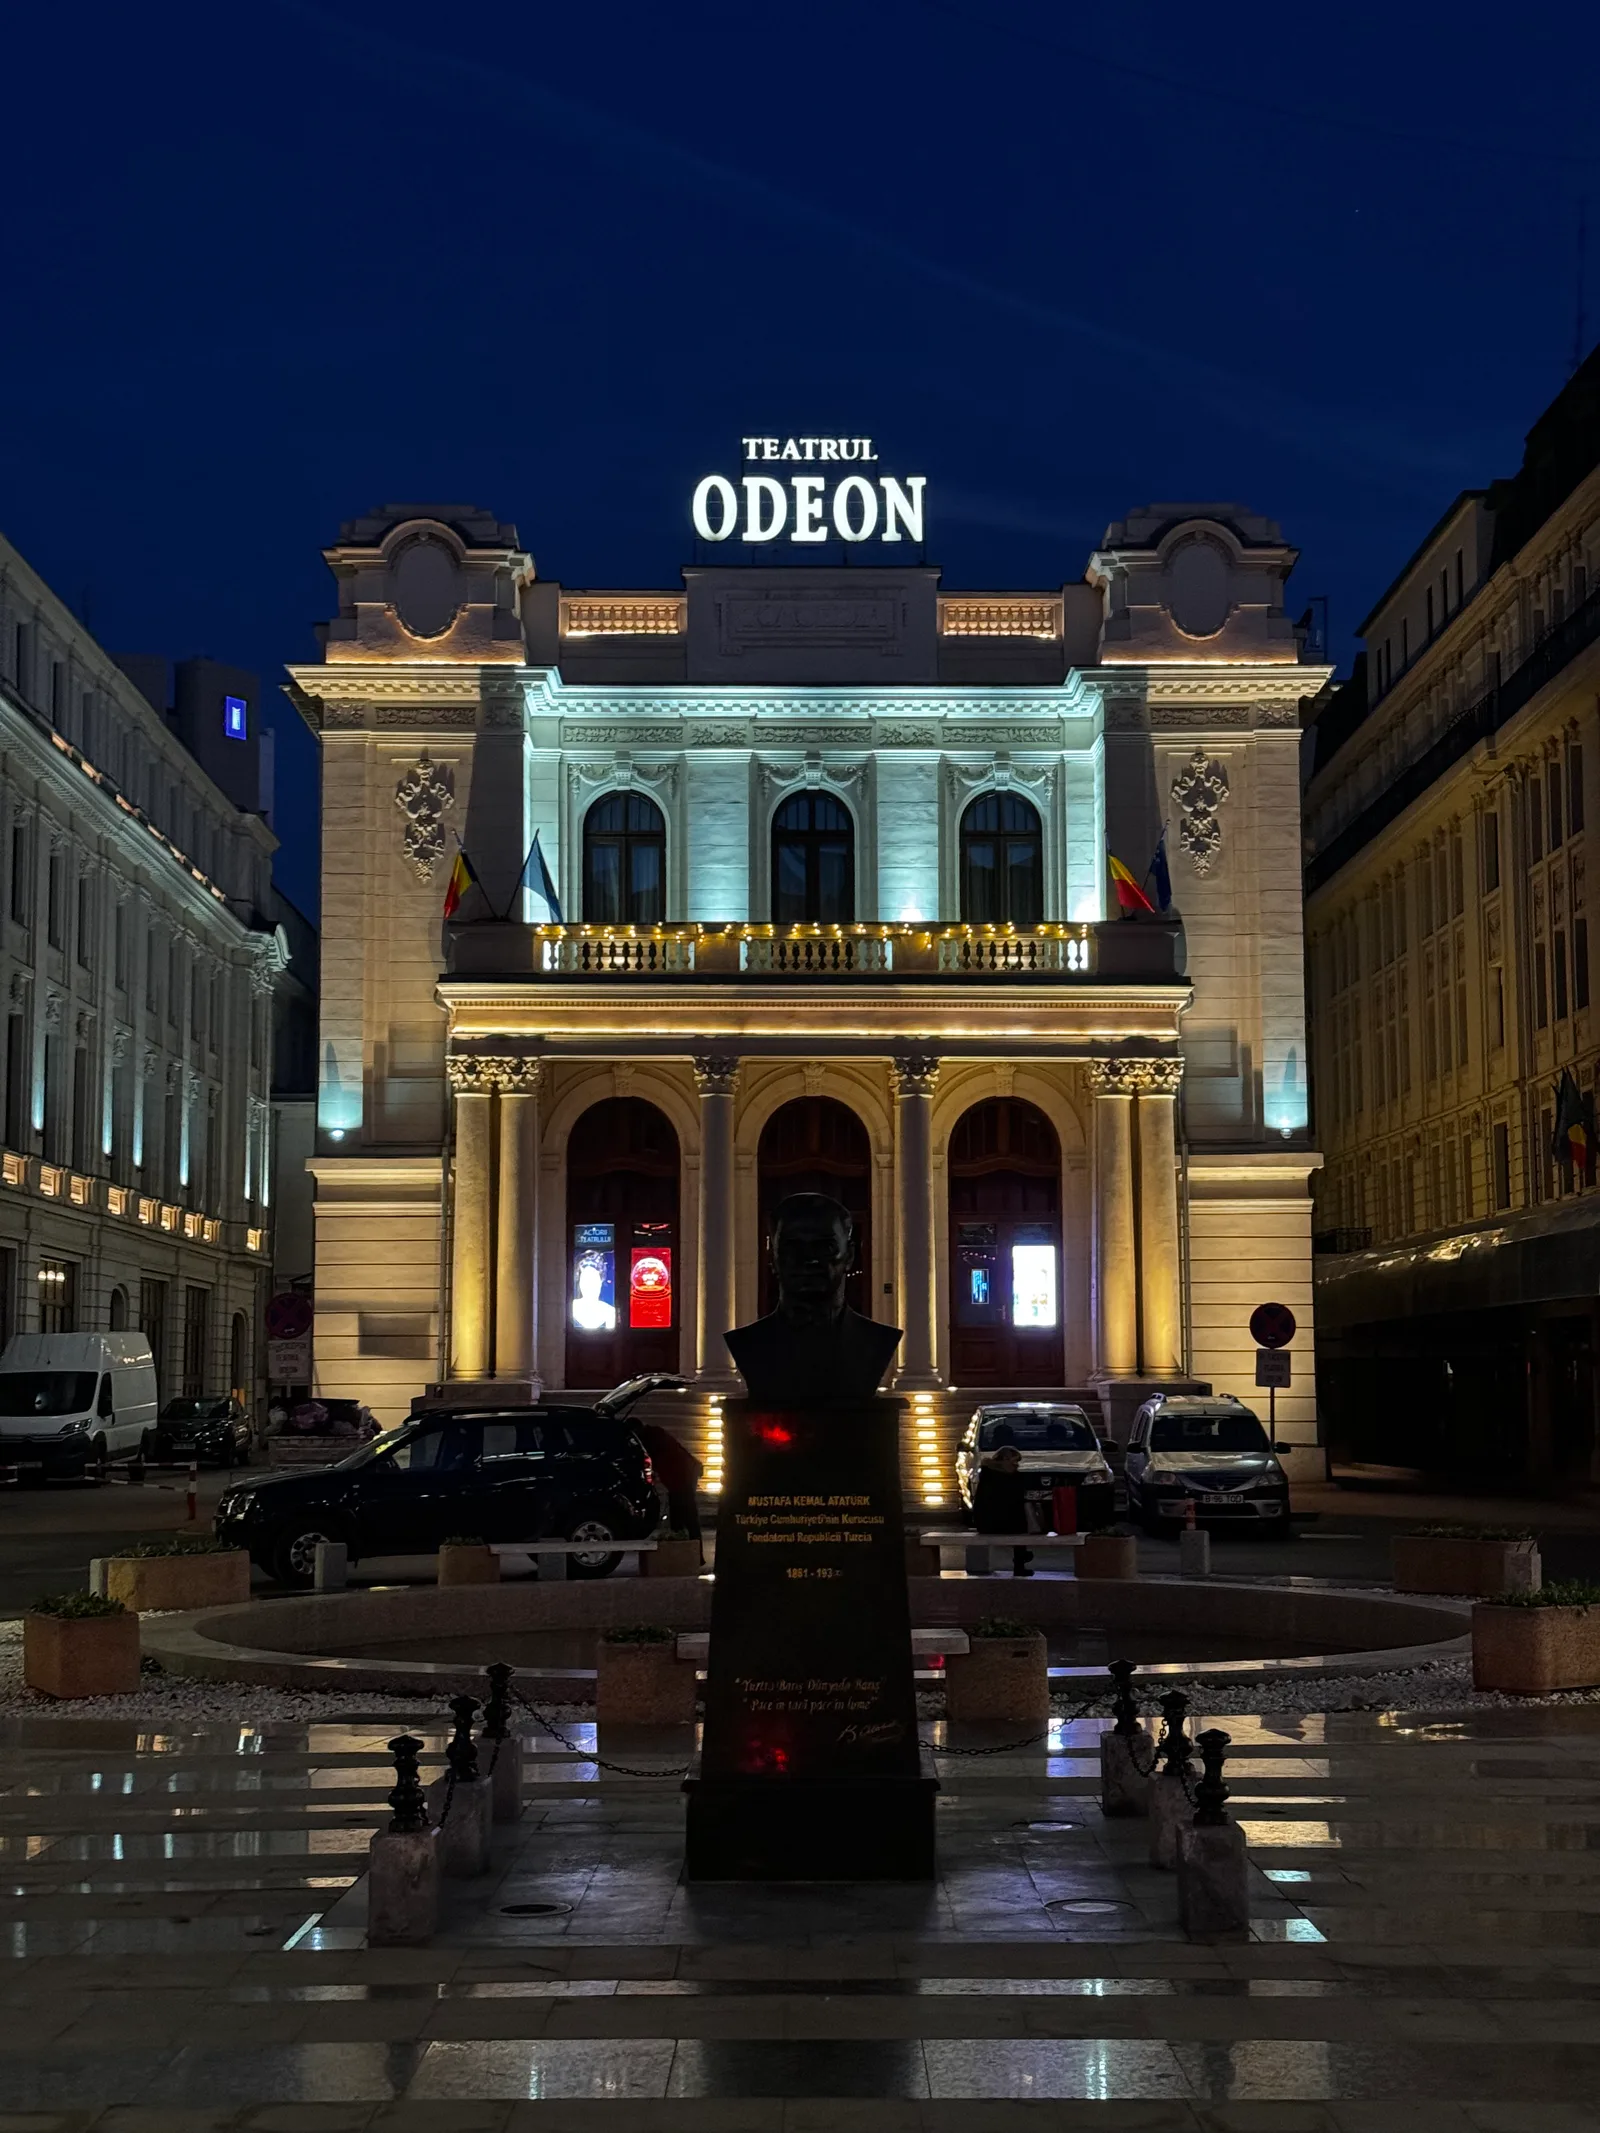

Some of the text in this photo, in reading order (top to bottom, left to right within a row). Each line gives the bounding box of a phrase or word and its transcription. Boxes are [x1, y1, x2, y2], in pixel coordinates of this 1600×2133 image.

[742, 438, 878, 460] TEATRUL
[692, 475, 927, 542] ODEON
[748, 1494, 871, 1507] MUSTAFA KEMAL ATATÜRK
[735, 1512, 769, 1527] Türkiye
[786, 1568, 808, 1578] 1881
